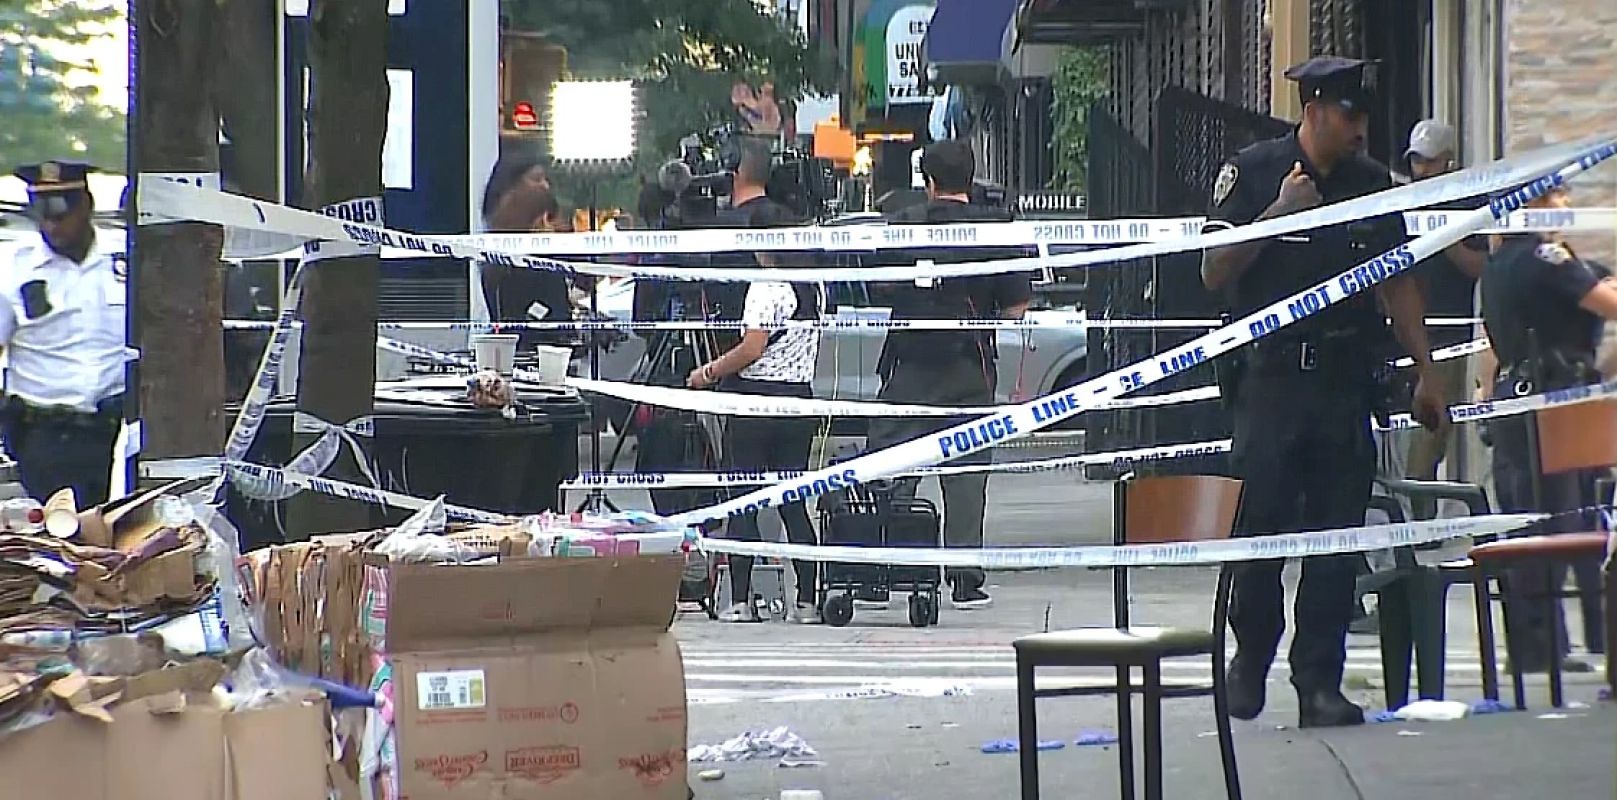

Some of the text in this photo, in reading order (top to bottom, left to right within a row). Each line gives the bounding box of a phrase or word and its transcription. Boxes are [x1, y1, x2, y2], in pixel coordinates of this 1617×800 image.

[1018, 195, 1086, 210] MOBILE
[939, 415, 1019, 457] POLICE
[1031, 393, 1080, 422] LINE
[1120, 371, 1145, 391] CE
[1160, 346, 1208, 375] LINE
[1249, 314, 1281, 338] DO
[1288, 284, 1333, 321] NOT
[1339, 244, 1415, 295] CROSS
